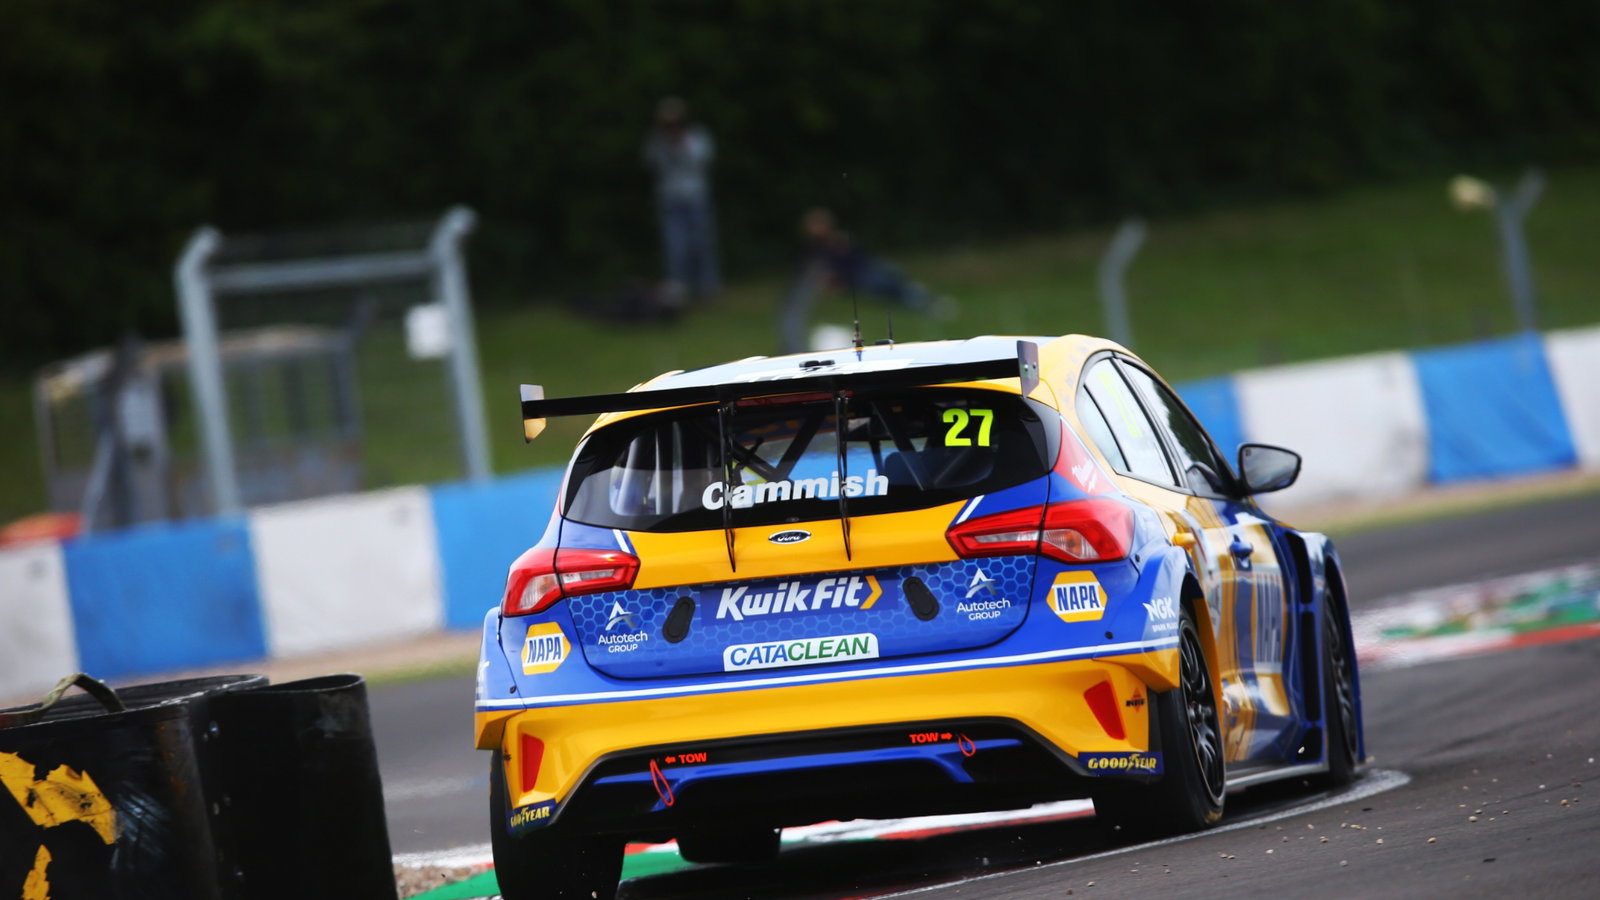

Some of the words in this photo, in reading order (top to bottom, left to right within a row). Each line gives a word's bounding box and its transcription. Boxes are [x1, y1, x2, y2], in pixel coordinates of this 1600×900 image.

[942, 408, 994, 447] 27
[702, 469, 889, 511] Cammish
[956, 598, 1011, 613] Autotech
[1056, 585, 1101, 611] NAPA
[968, 611, 1001, 621] GROUP
[1142, 596, 1176, 621] NGK
[598, 630, 648, 645] Autotech
[527, 637, 562, 663] NAPA
[608, 643, 638, 653] GROUP
[730, 636, 870, 666] CATACLEAN
[909, 732, 939, 744] TOW
[678, 752, 707, 764] TOW
[1088, 754, 1157, 770] GOODYEAR
